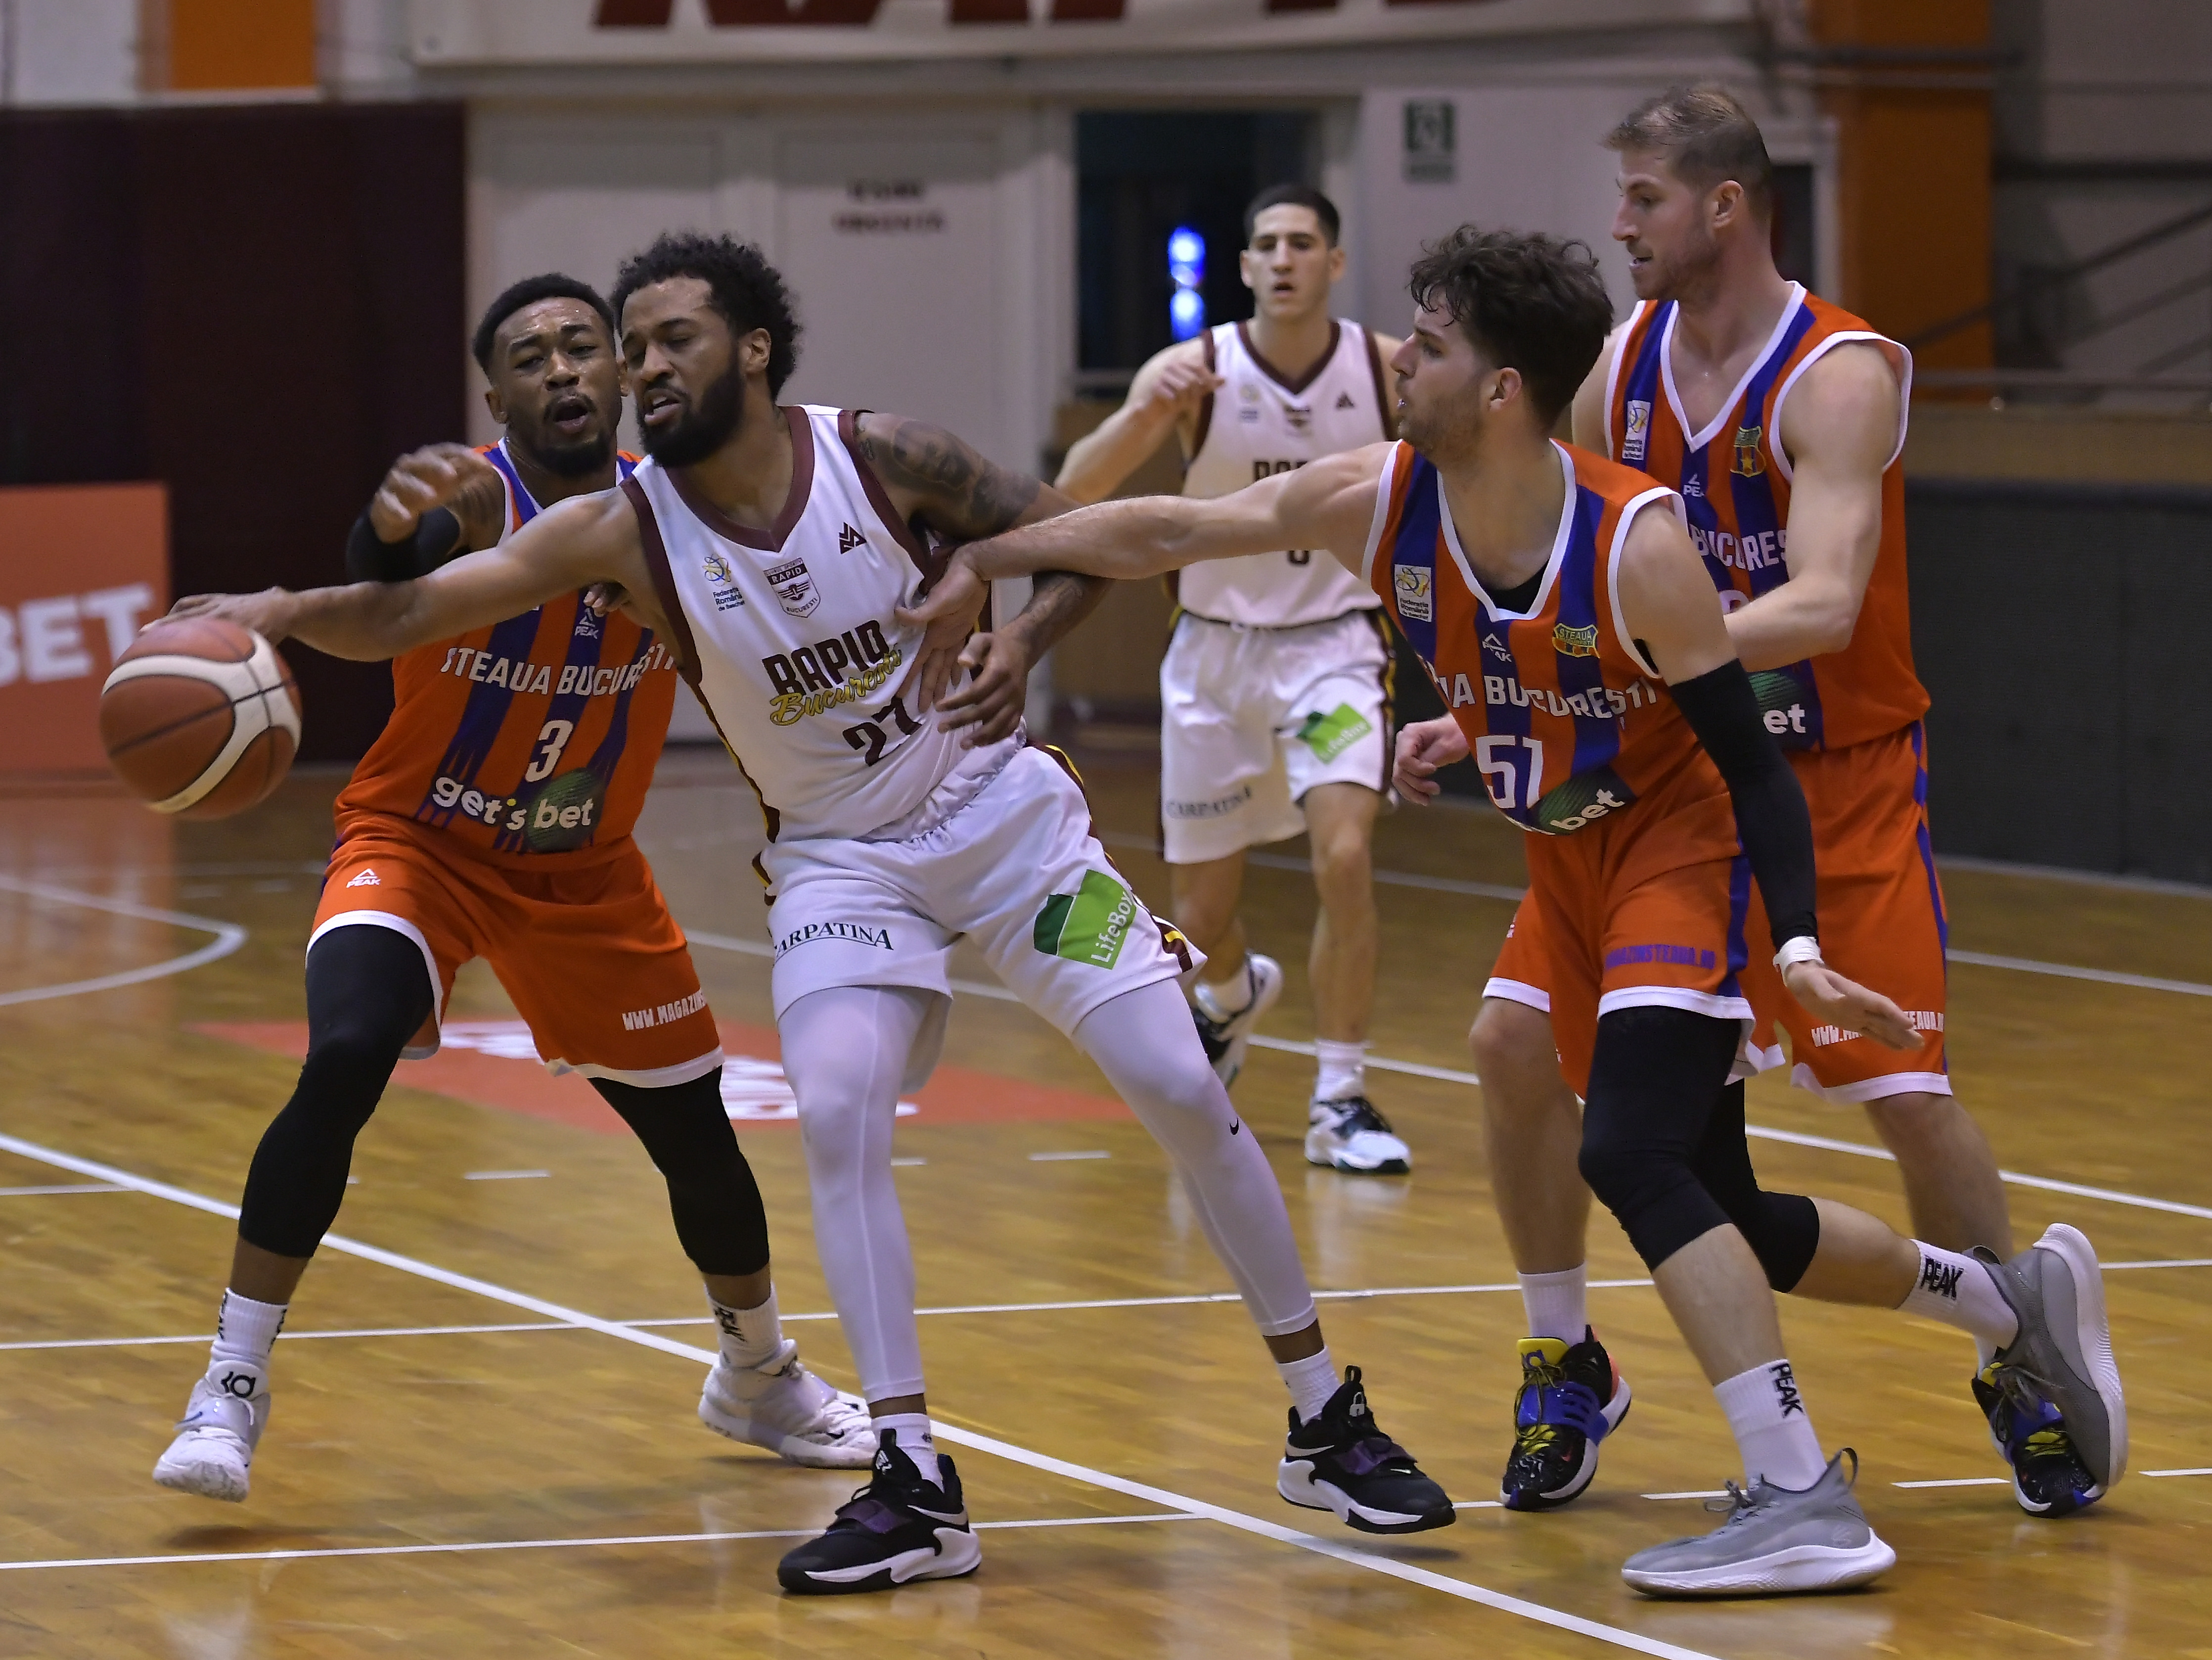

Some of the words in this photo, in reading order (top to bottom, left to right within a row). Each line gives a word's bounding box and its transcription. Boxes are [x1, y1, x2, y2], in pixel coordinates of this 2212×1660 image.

[770, 566, 802, 583] RAPID
[574, 625, 599, 639] PEAK
[1558, 628, 1592, 641] STEAUA
[440, 647, 551, 695] STEAUA
[762, 619, 891, 697] RAPID
[842, 697, 923, 767] 27
[1763, 703, 1806, 734] et
[524, 719, 574, 783] 3
[1474, 735, 1544, 810] 57
[534, 797, 594, 830] bet
[1550, 787, 1626, 831] bet
[346, 878, 381, 888] PEAK
[774, 922, 894, 958] ARPATINA
[1921, 1254, 1964, 1301] PEAK
[1769, 1362, 1806, 1418] PEAK
